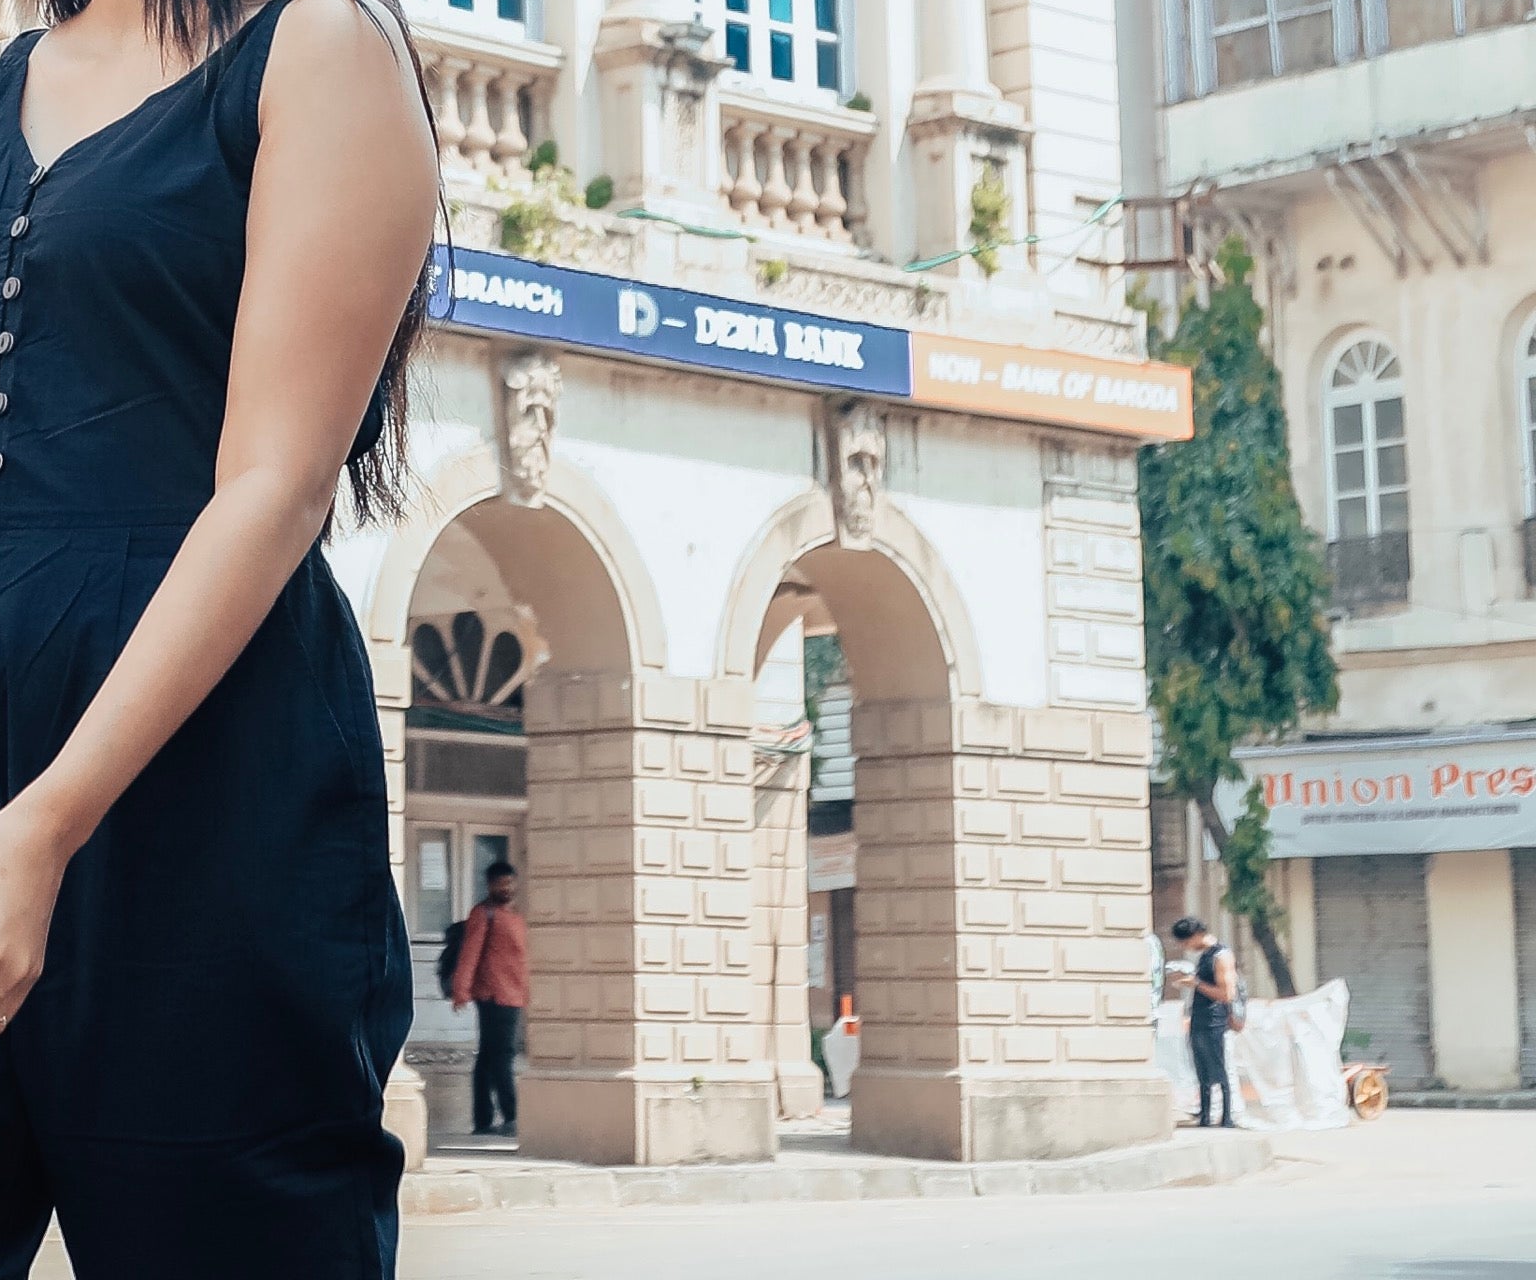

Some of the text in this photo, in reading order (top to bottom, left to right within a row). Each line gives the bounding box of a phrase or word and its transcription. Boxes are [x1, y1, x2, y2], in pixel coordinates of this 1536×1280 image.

[448, 268, 563, 317] BRANCH
[694, 306, 779, 356] DENA
[784, 321, 864, 370] BANK
[928, 351, 982, 385] NOW
[1001, 362, 1064, 396] BANK
[1063, 372, 1095, 400] OF
[1095, 375, 1180, 413] BARODA
[1263, 770, 1414, 808] Union
